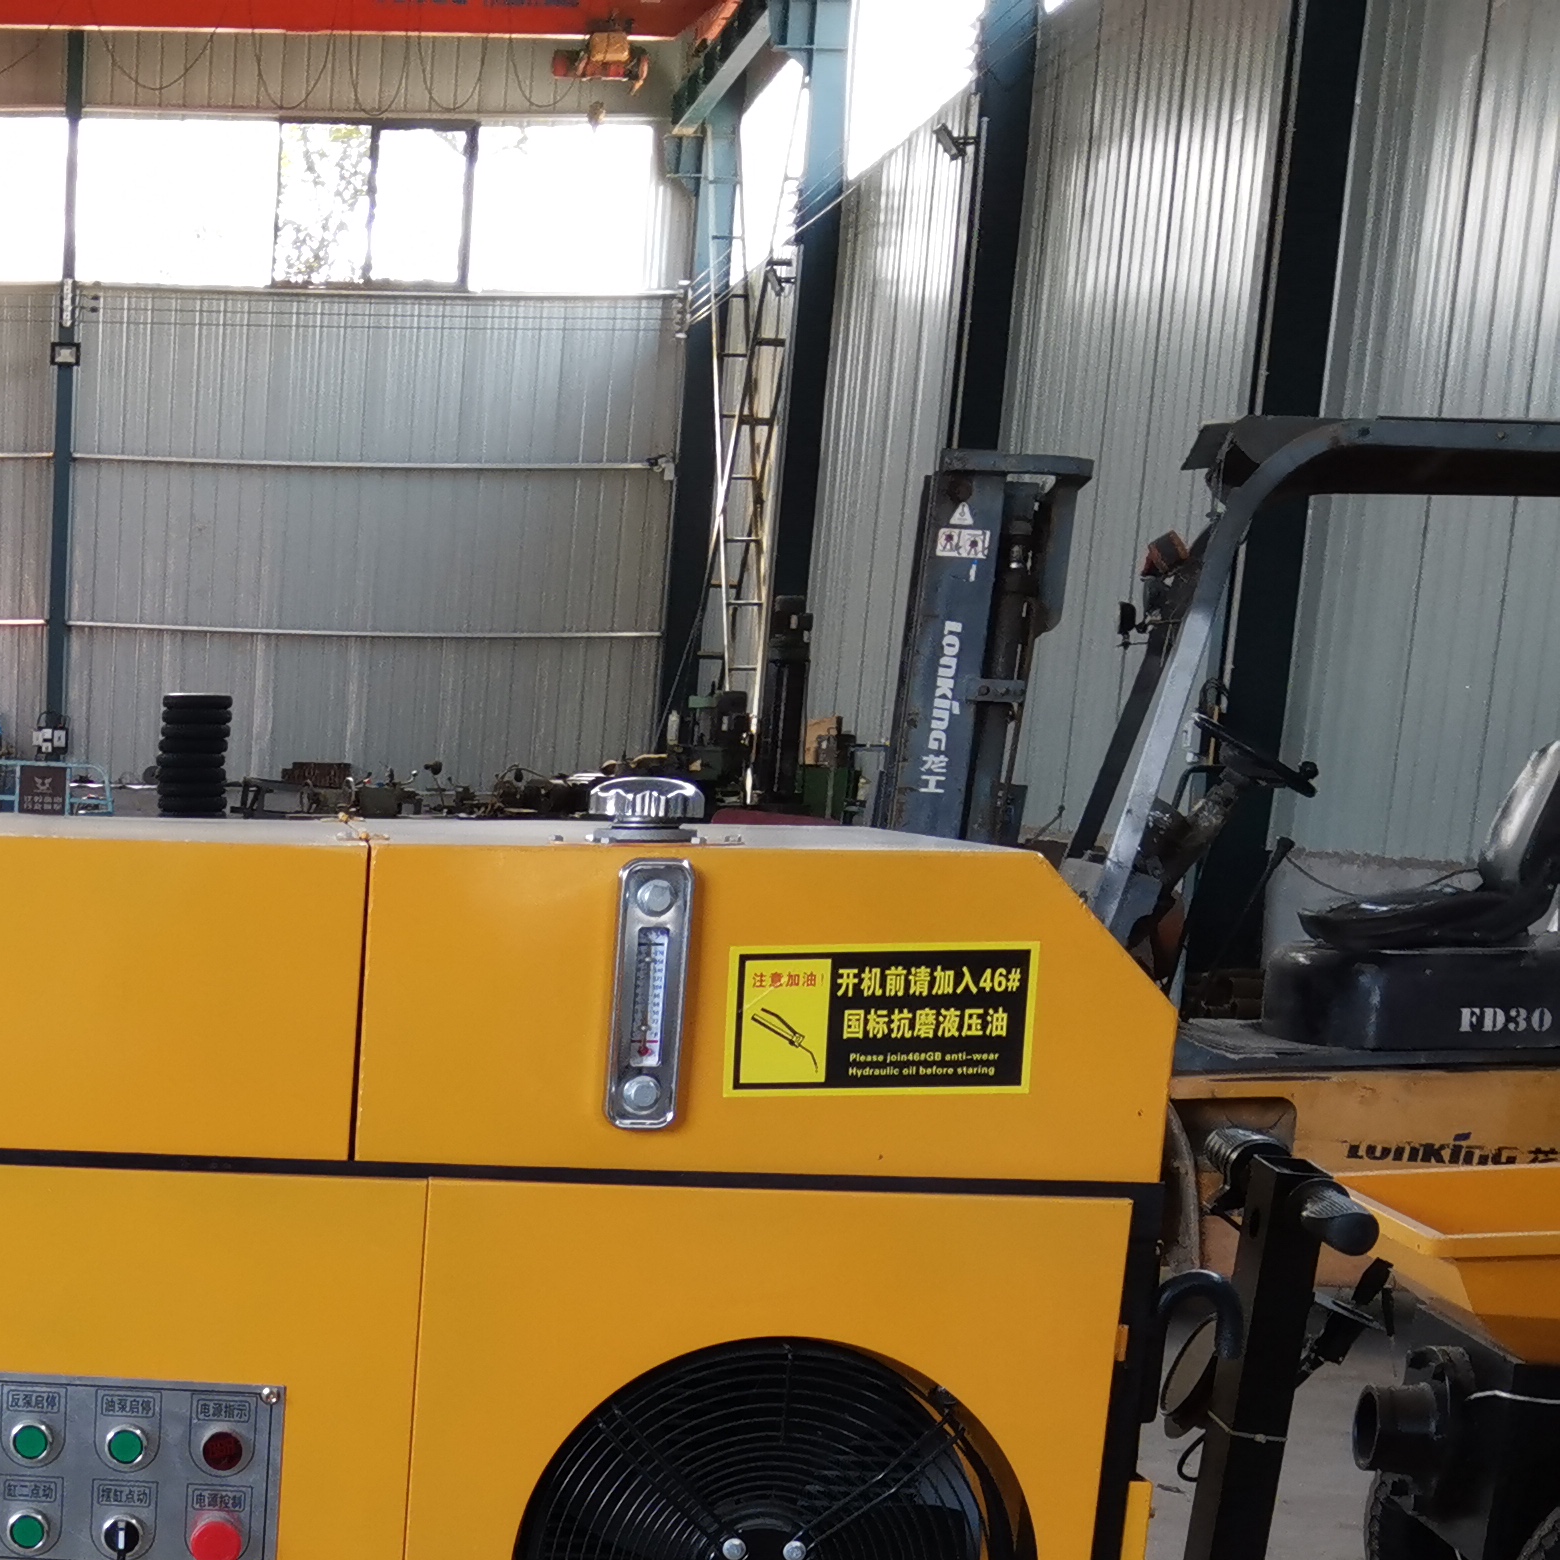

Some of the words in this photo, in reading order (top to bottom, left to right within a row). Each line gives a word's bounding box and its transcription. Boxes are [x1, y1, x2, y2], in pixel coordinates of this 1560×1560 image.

[918, 754, 949, 794] 龙工
[836, 966, 1022, 998] 开机前请加入46#
[842, 1006, 1008, 1040] 国标抗磨液压油
[1458, 1007, 1553, 1033] FD30
[849, 1052, 884, 1063] Please
[945, 1051, 1000, 1062] anti-wear
[848, 1065, 900, 1078] Hydraulic
[902, 1065, 917, 1076] oil
[919, 1065, 954, 1076] before
[9, 1393, 59, 1411] 反泵启停
[104, 1397, 152, 1415] 油泵启停
[200, 1402, 248, 1420] 电源指示
[195, 1493, 243, 1510] 电源控制
